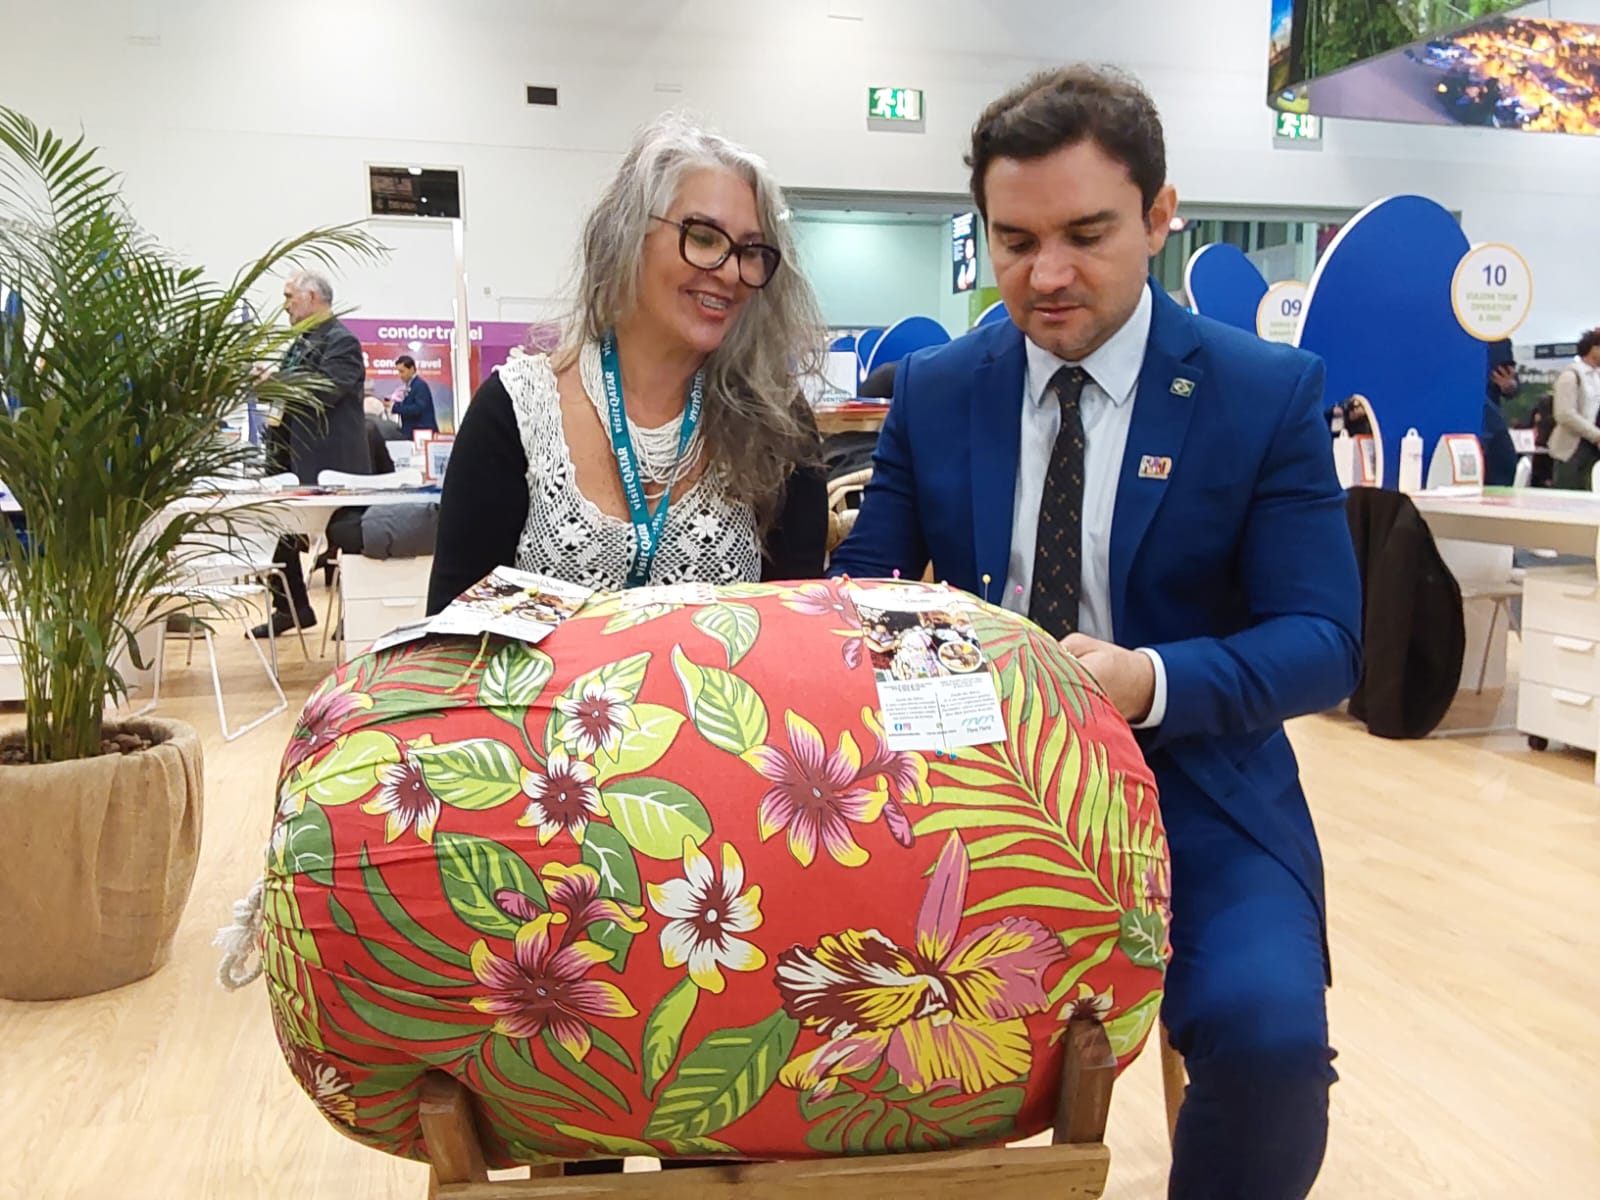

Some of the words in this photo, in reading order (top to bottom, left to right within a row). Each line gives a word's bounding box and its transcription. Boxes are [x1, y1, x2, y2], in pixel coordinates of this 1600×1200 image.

[1482, 264, 1507, 287] 10
[1281, 298, 1302, 317] 09
[377, 324, 483, 340] condortrel
[605, 371, 622, 433] visitQATAR
[617, 447, 642, 511] visitQATAR
